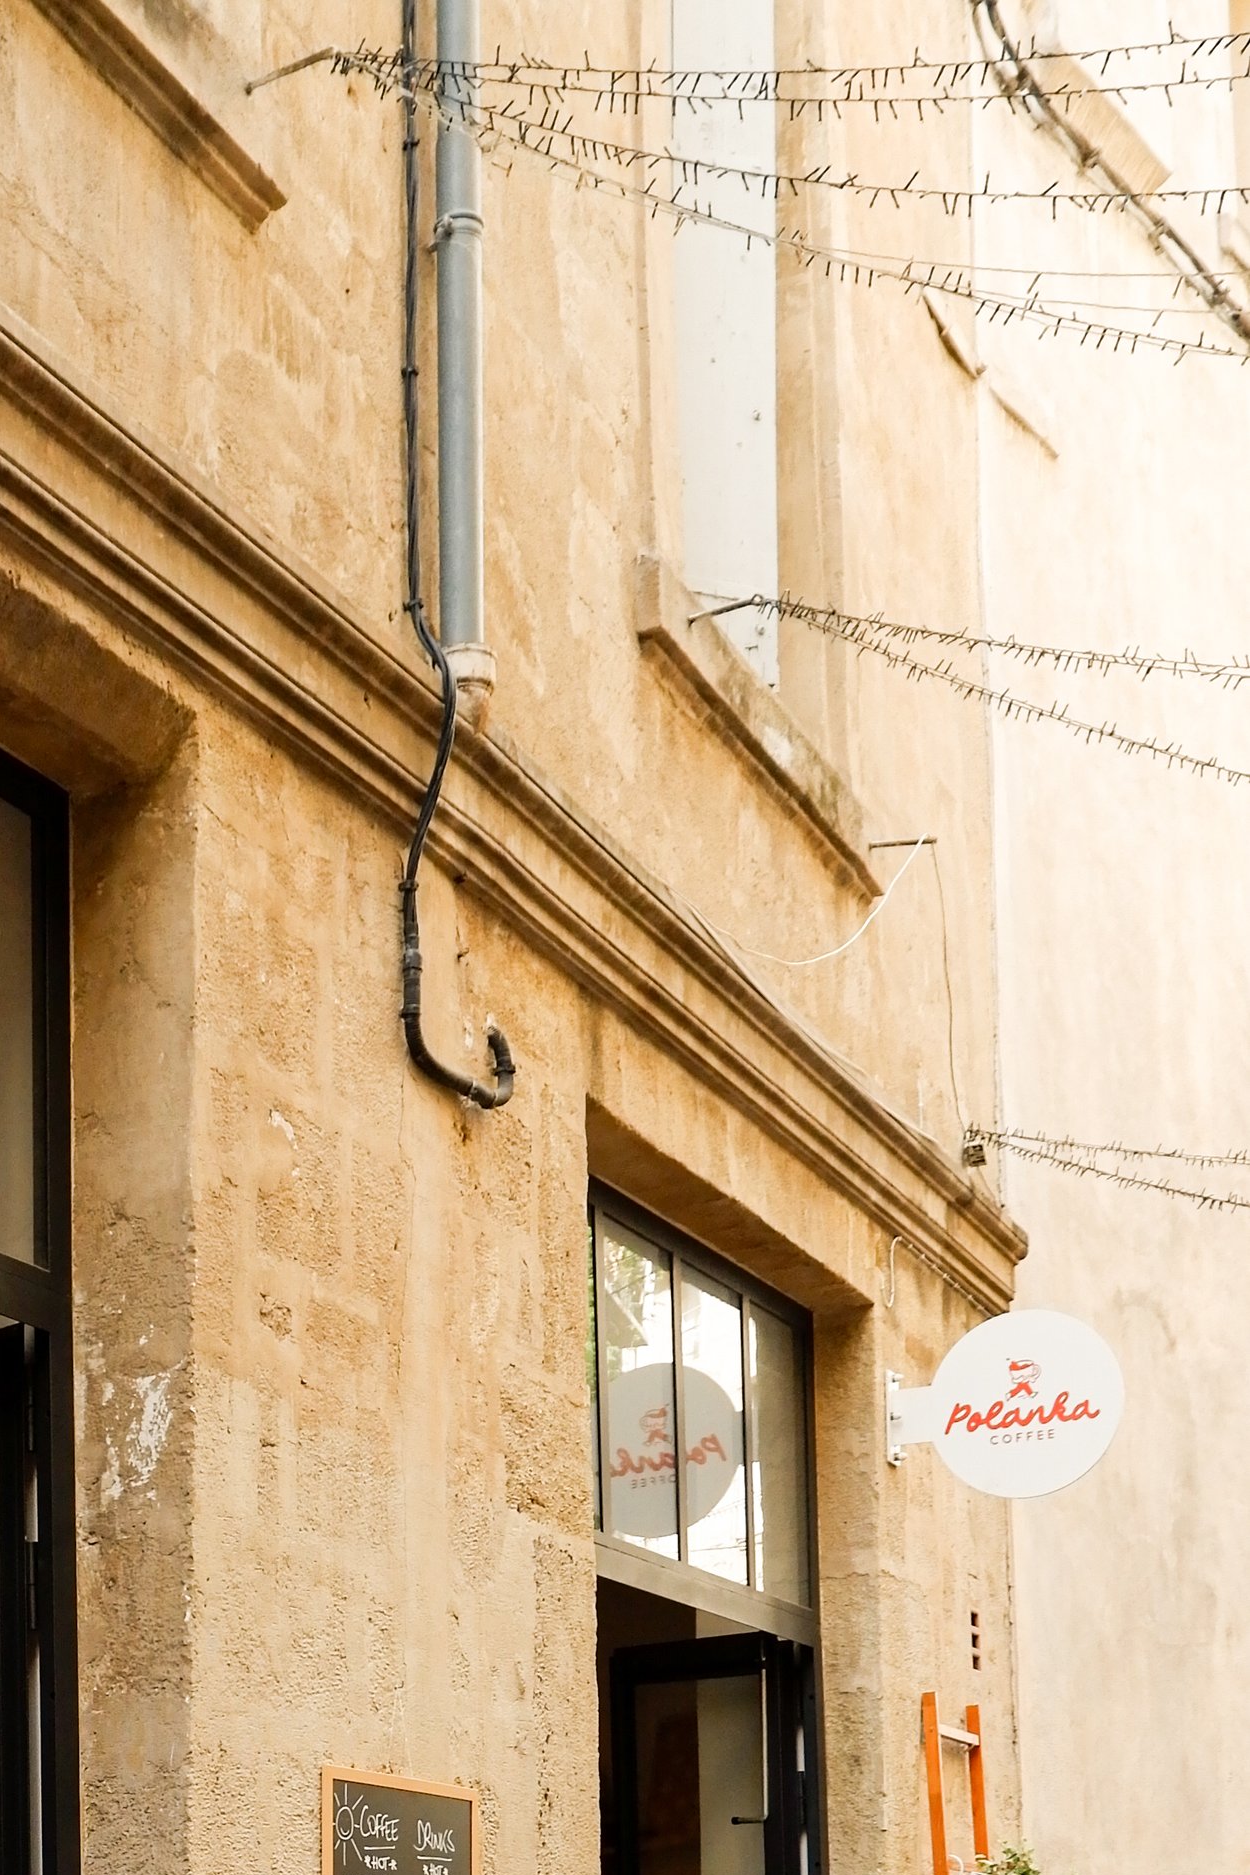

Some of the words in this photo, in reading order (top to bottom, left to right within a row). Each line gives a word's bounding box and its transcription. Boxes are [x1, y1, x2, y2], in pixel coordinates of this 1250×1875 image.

[944, 1391, 1101, 1436] Polanka
[990, 1429, 1055, 1445] COFFEE
[360, 1805, 400, 1841] COFFEE
[413, 1819, 455, 1853] DRINKS
